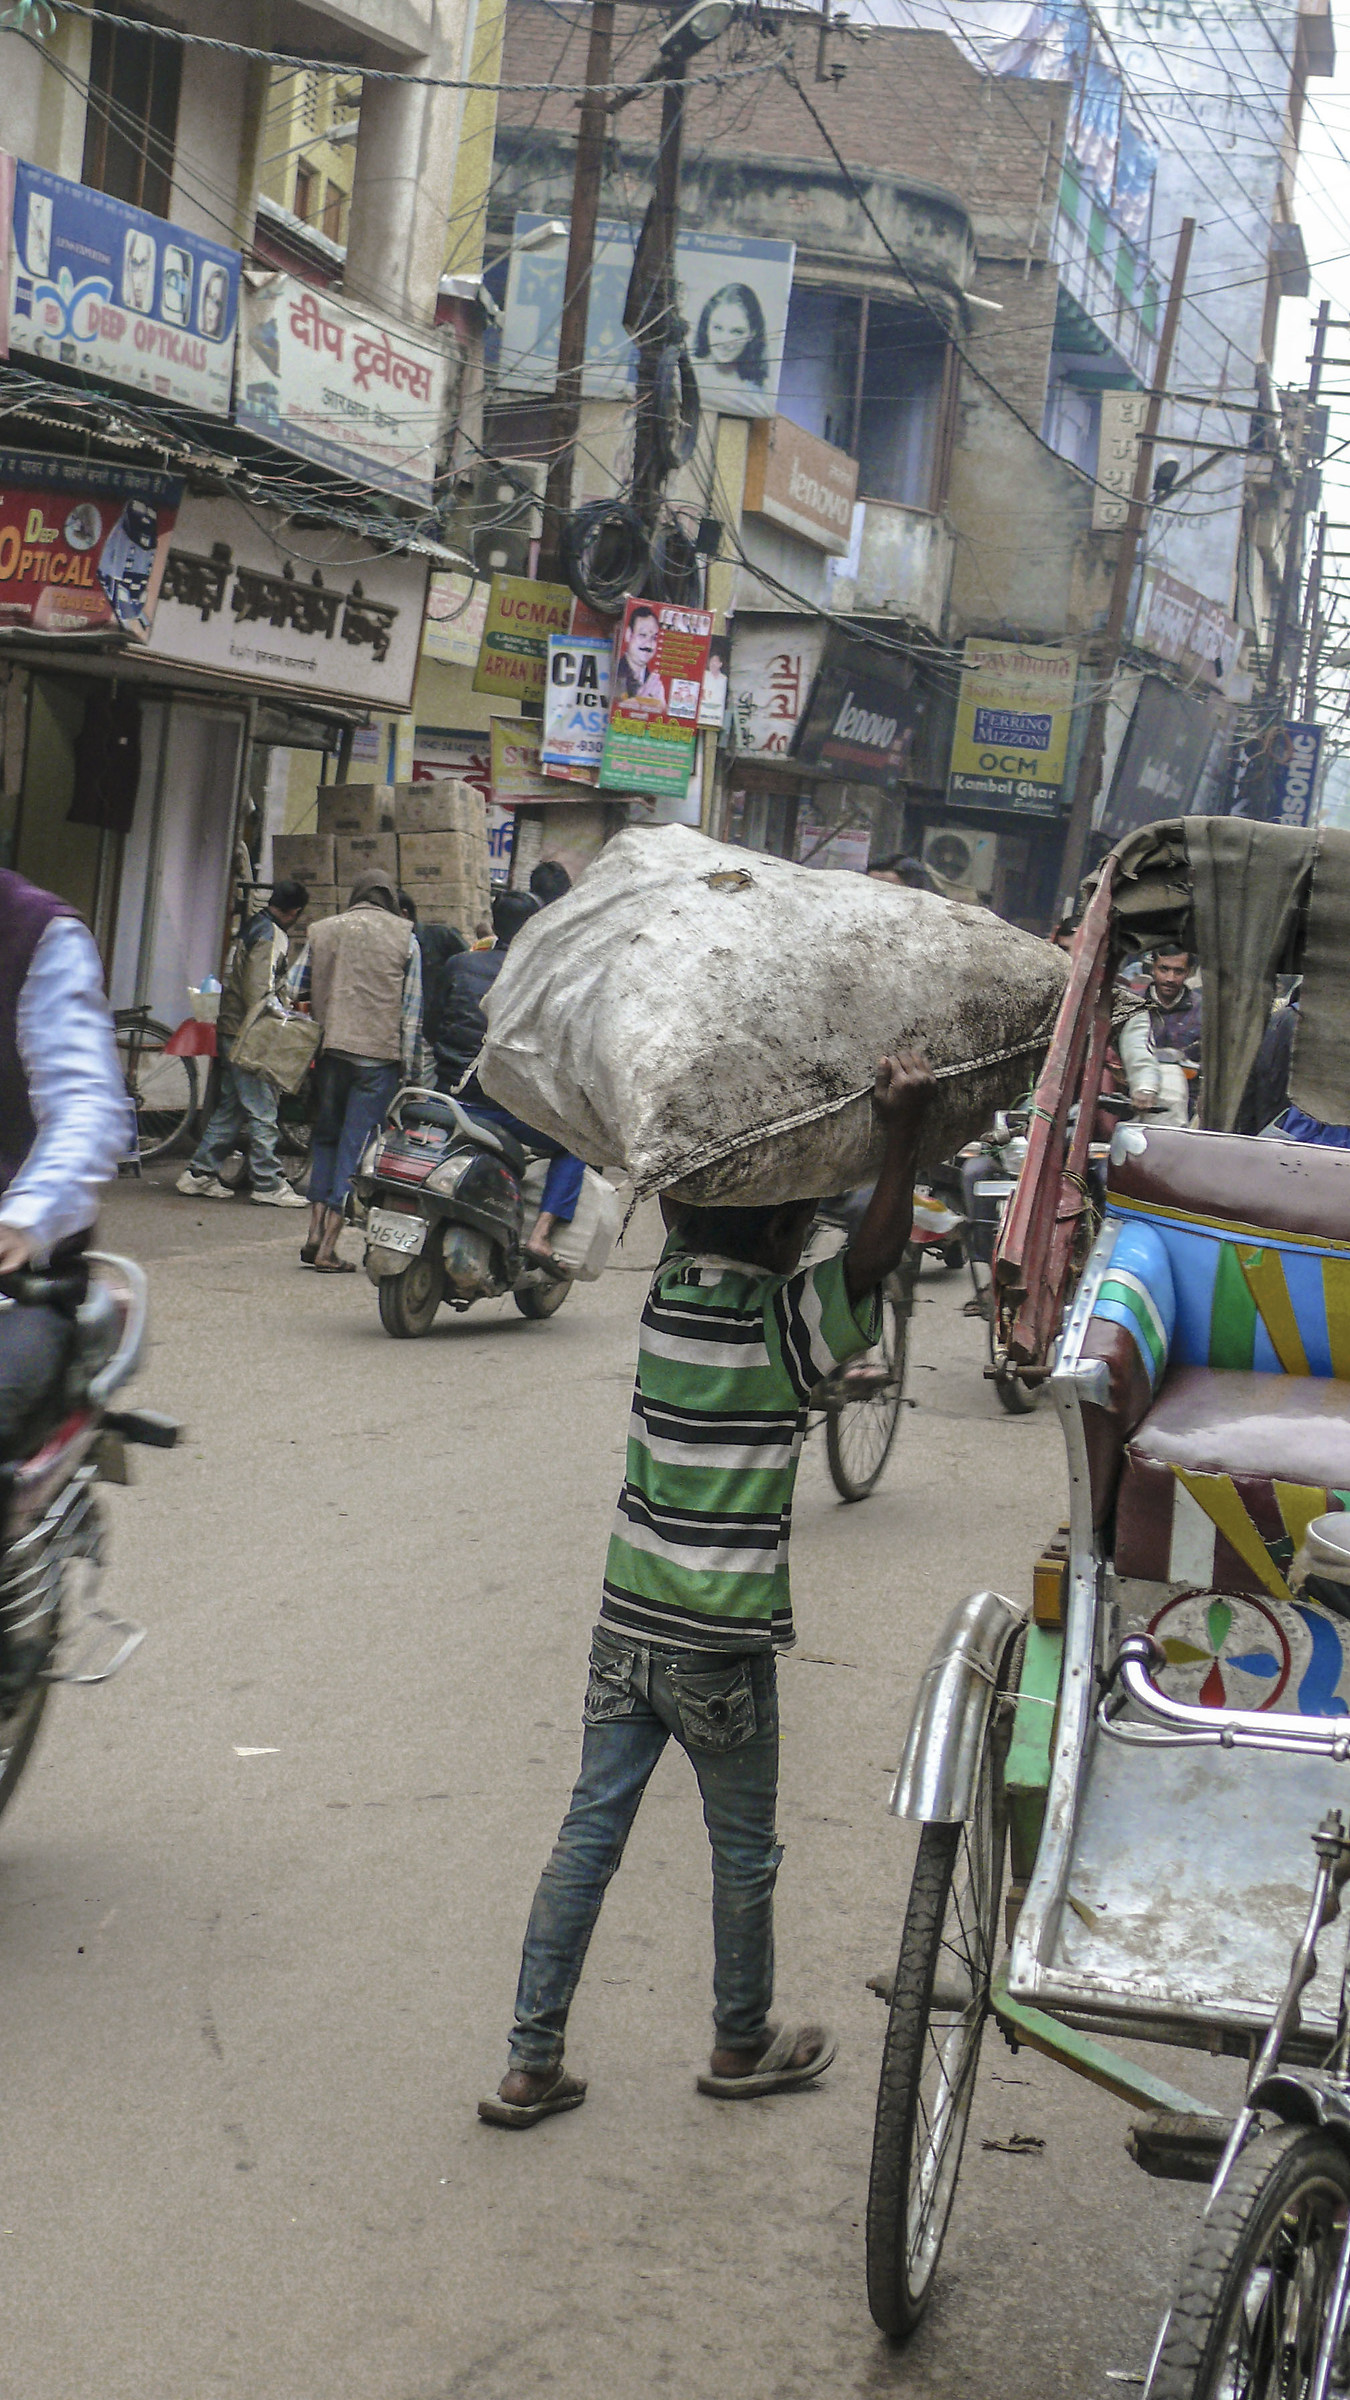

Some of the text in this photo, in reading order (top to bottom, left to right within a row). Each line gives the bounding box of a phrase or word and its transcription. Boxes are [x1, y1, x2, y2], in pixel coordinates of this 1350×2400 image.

[87, 302, 127, 343] DEEP
[134, 320, 208, 372] OPTICALS
[289, 294, 345, 361] दीप
[789, 456, 850, 525] lenovo
[0, 525, 94, 588] OPTICAL
[500, 597, 571, 630] UCMAS
[552, 652, 599, 689] CA
[832, 691, 898, 749] lenovo
[976, 728, 1048, 747] MIZZONI
[978, 711, 1050, 732] FERRINO
[978, 752, 1038, 776] OCM
[1281, 733, 1317, 827] asonic
[953, 775, 1057, 800] Kambal Ghar
[369, 1222, 419, 1248] 4642
